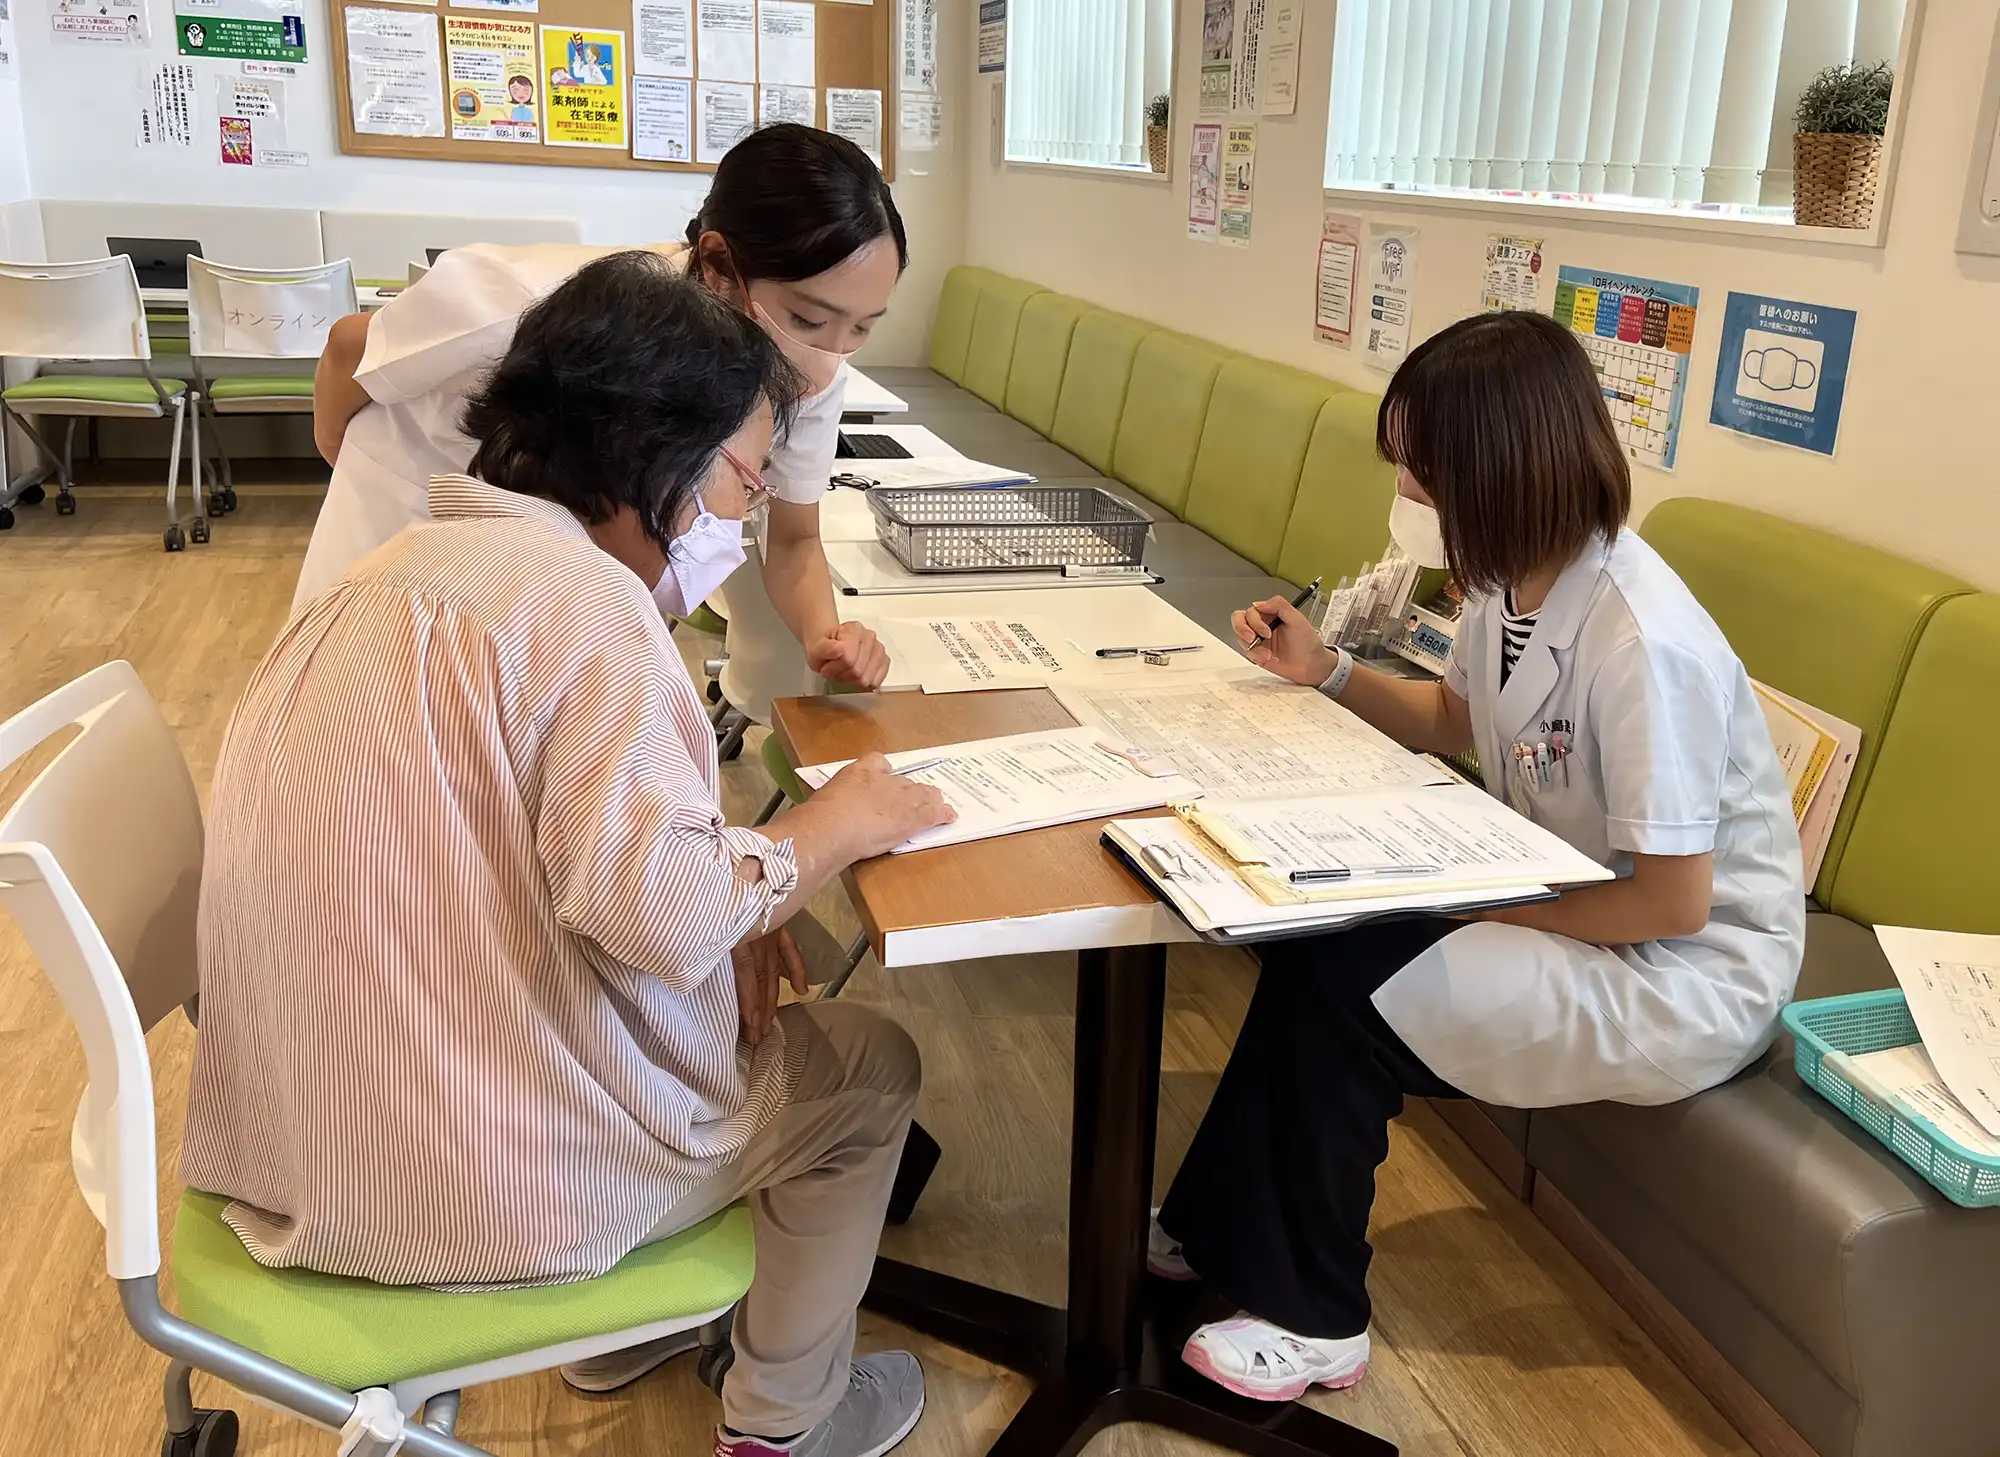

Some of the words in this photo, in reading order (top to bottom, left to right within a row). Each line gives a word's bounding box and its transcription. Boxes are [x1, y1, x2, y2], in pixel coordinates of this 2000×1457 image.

[448, 20, 531, 34] 生活習慣病が気になる方
[570, 109, 619, 123] 在宅医療
[1385, 242, 1403, 260] Free
[1496, 245, 1531, 261] 健康フェア
[226, 308, 327, 331] オンライン
[1759, 303, 1819, 324] 皆様へのお願い
